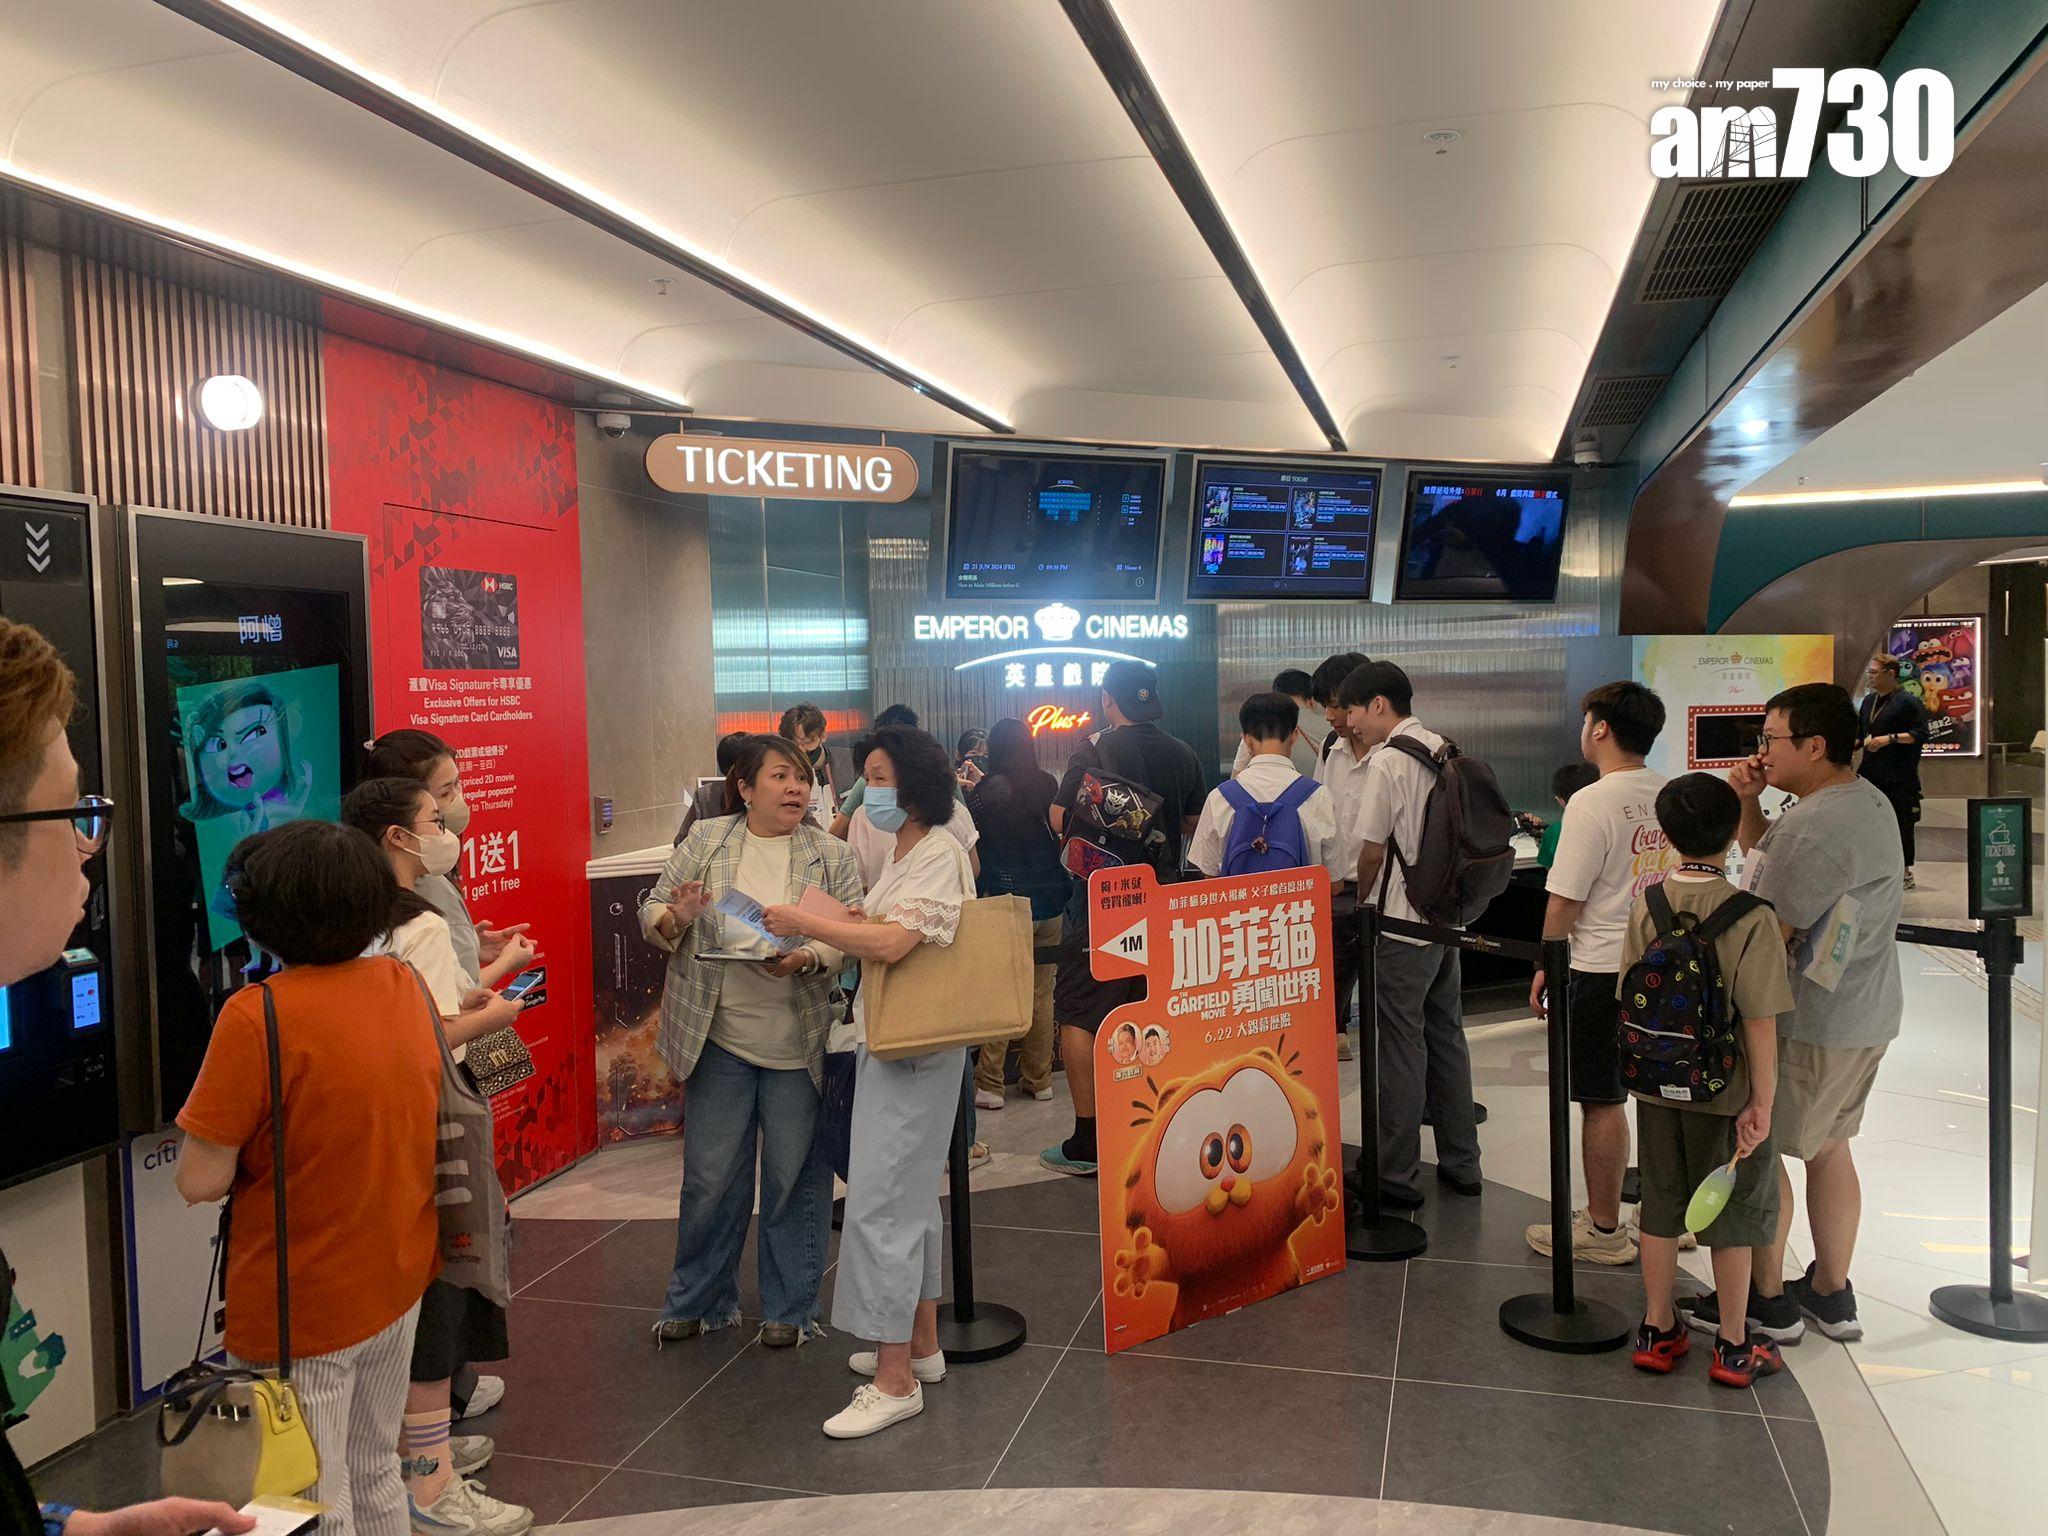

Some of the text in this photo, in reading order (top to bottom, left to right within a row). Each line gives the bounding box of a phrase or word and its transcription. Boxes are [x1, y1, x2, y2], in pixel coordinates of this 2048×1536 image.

[676, 445, 893, 492] TICKETING
[499, 582, 513, 590] HSBC
[238, 614, 283, 644] 阿憎
[914, 614, 1188, 639] EMPEROR CINEMAS
[496, 646, 517, 659] VISA
[1744, 656, 1774, 665] CINEMAS
[424, 695, 521, 709] Exclusive Offers for HSBC
[410, 710, 533, 726] Visa Signature Card Cardholders
[484, 774, 494, 784] 2D
[495, 772, 515, 783] movie
[472, 798, 513, 812] to Thursday)
[1623, 802, 1659, 820] EN
[462, 829, 520, 880] 1送1
[471, 882, 489, 901] get
[492, 879, 497, 894] 1
[500, 876, 521, 892] free
[1120, 934, 1143, 953] 1M
[1169, 899, 1317, 992] 加菲貓
[1232, 968, 1321, 1017] 勇闖世界
[1167, 991, 1231, 1017] GARFIELD
[1201, 1008, 1227, 1021] MOVIE
[1204, 1026, 1233, 1044] 6.22
[86, 1062, 103, 1073] SCAN
[144, 1144, 177, 1171] citi
